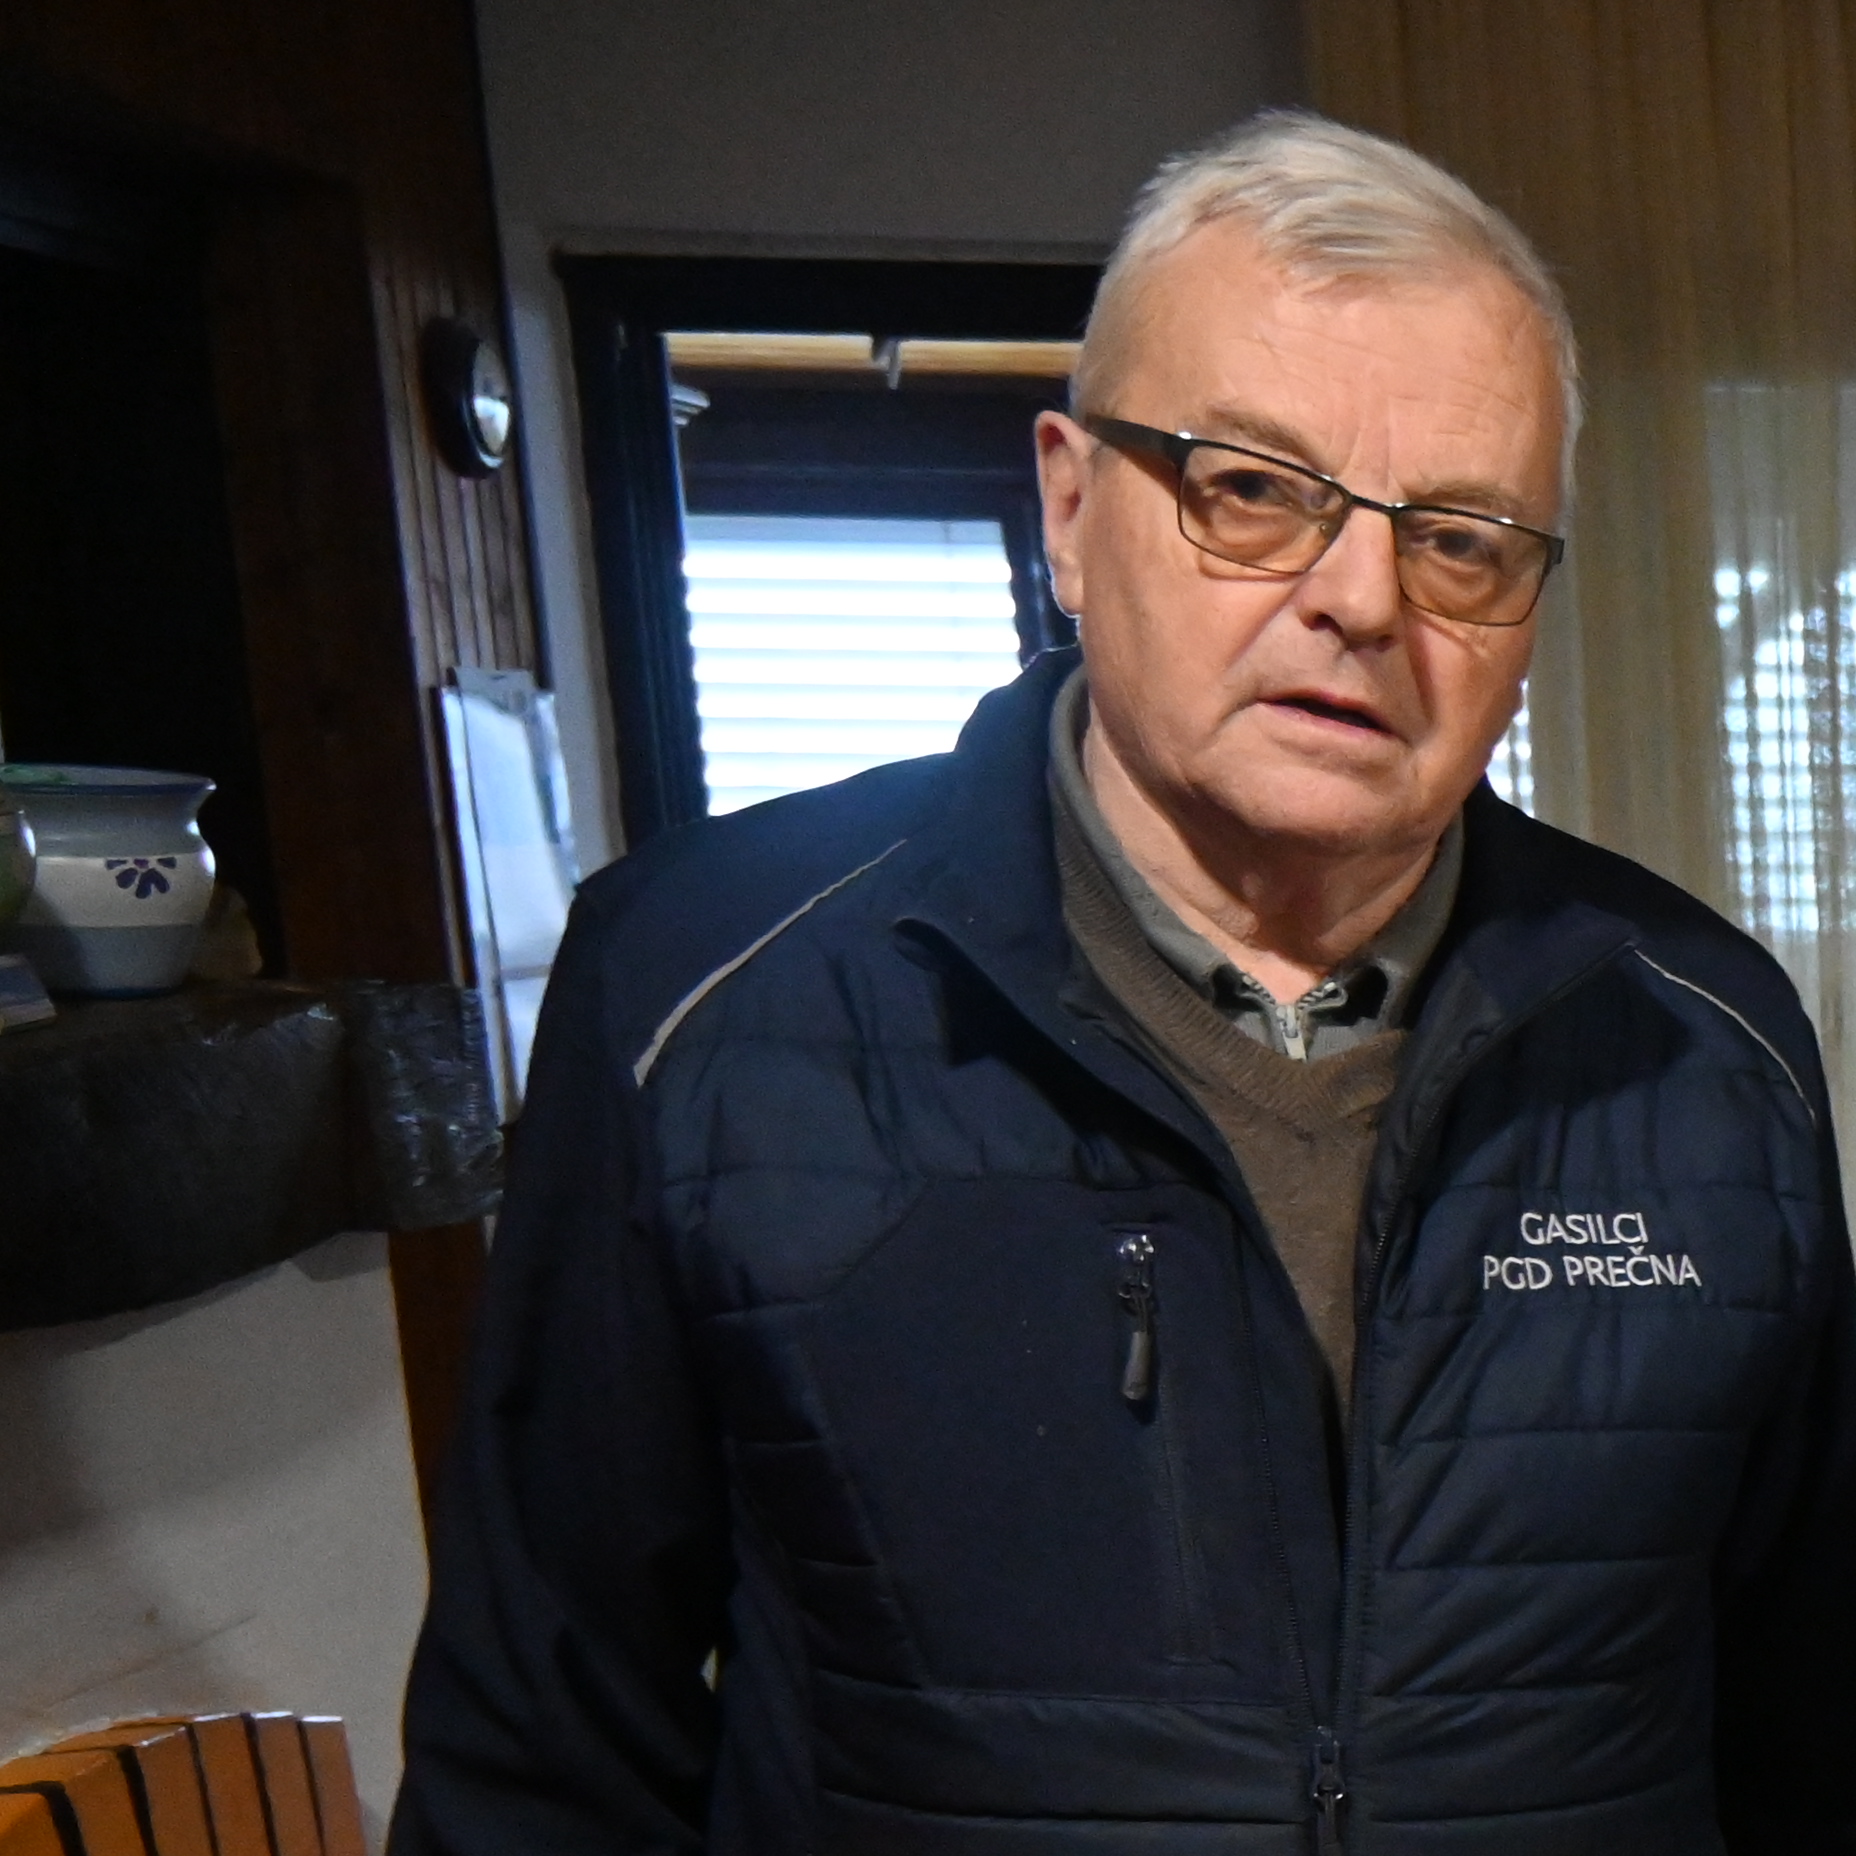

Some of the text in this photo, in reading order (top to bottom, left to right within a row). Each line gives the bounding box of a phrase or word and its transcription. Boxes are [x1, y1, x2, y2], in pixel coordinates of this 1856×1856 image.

[1520, 1212, 1649, 1245] GASILCI
[1483, 1245, 1702, 1290] PGD PREČNA
